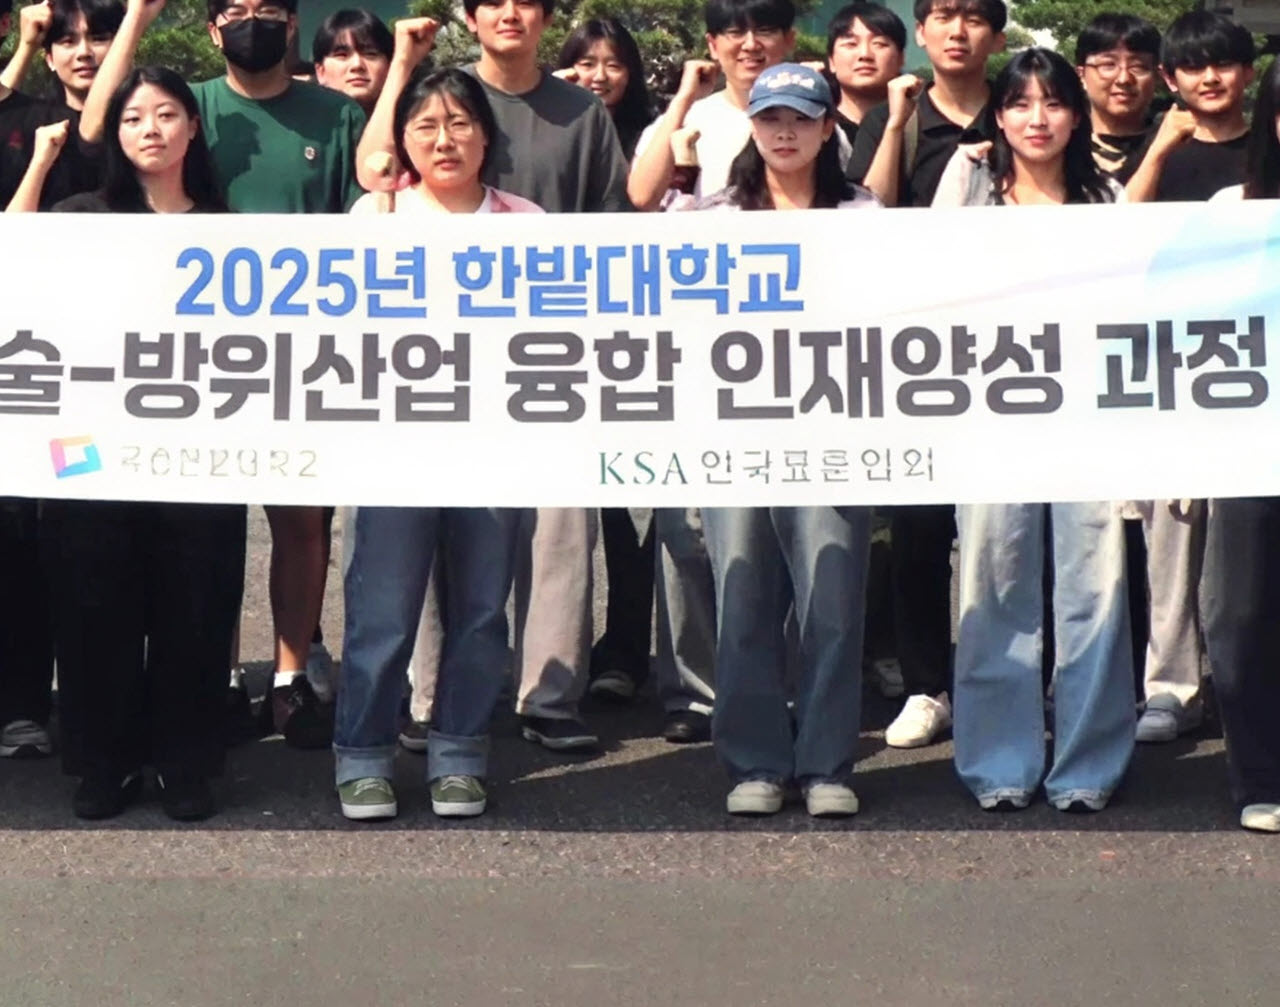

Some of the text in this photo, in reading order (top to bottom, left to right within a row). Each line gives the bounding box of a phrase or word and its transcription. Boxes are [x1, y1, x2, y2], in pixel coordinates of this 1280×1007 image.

[175, 242, 805, 317] 2025년 한밭대학교
[505, 330, 682, 423] 융합
[711, 323, 1063, 420] 인재양성
[1096, 315, 1270, 410] 과정
[598, 451, 688, 485] KSA
